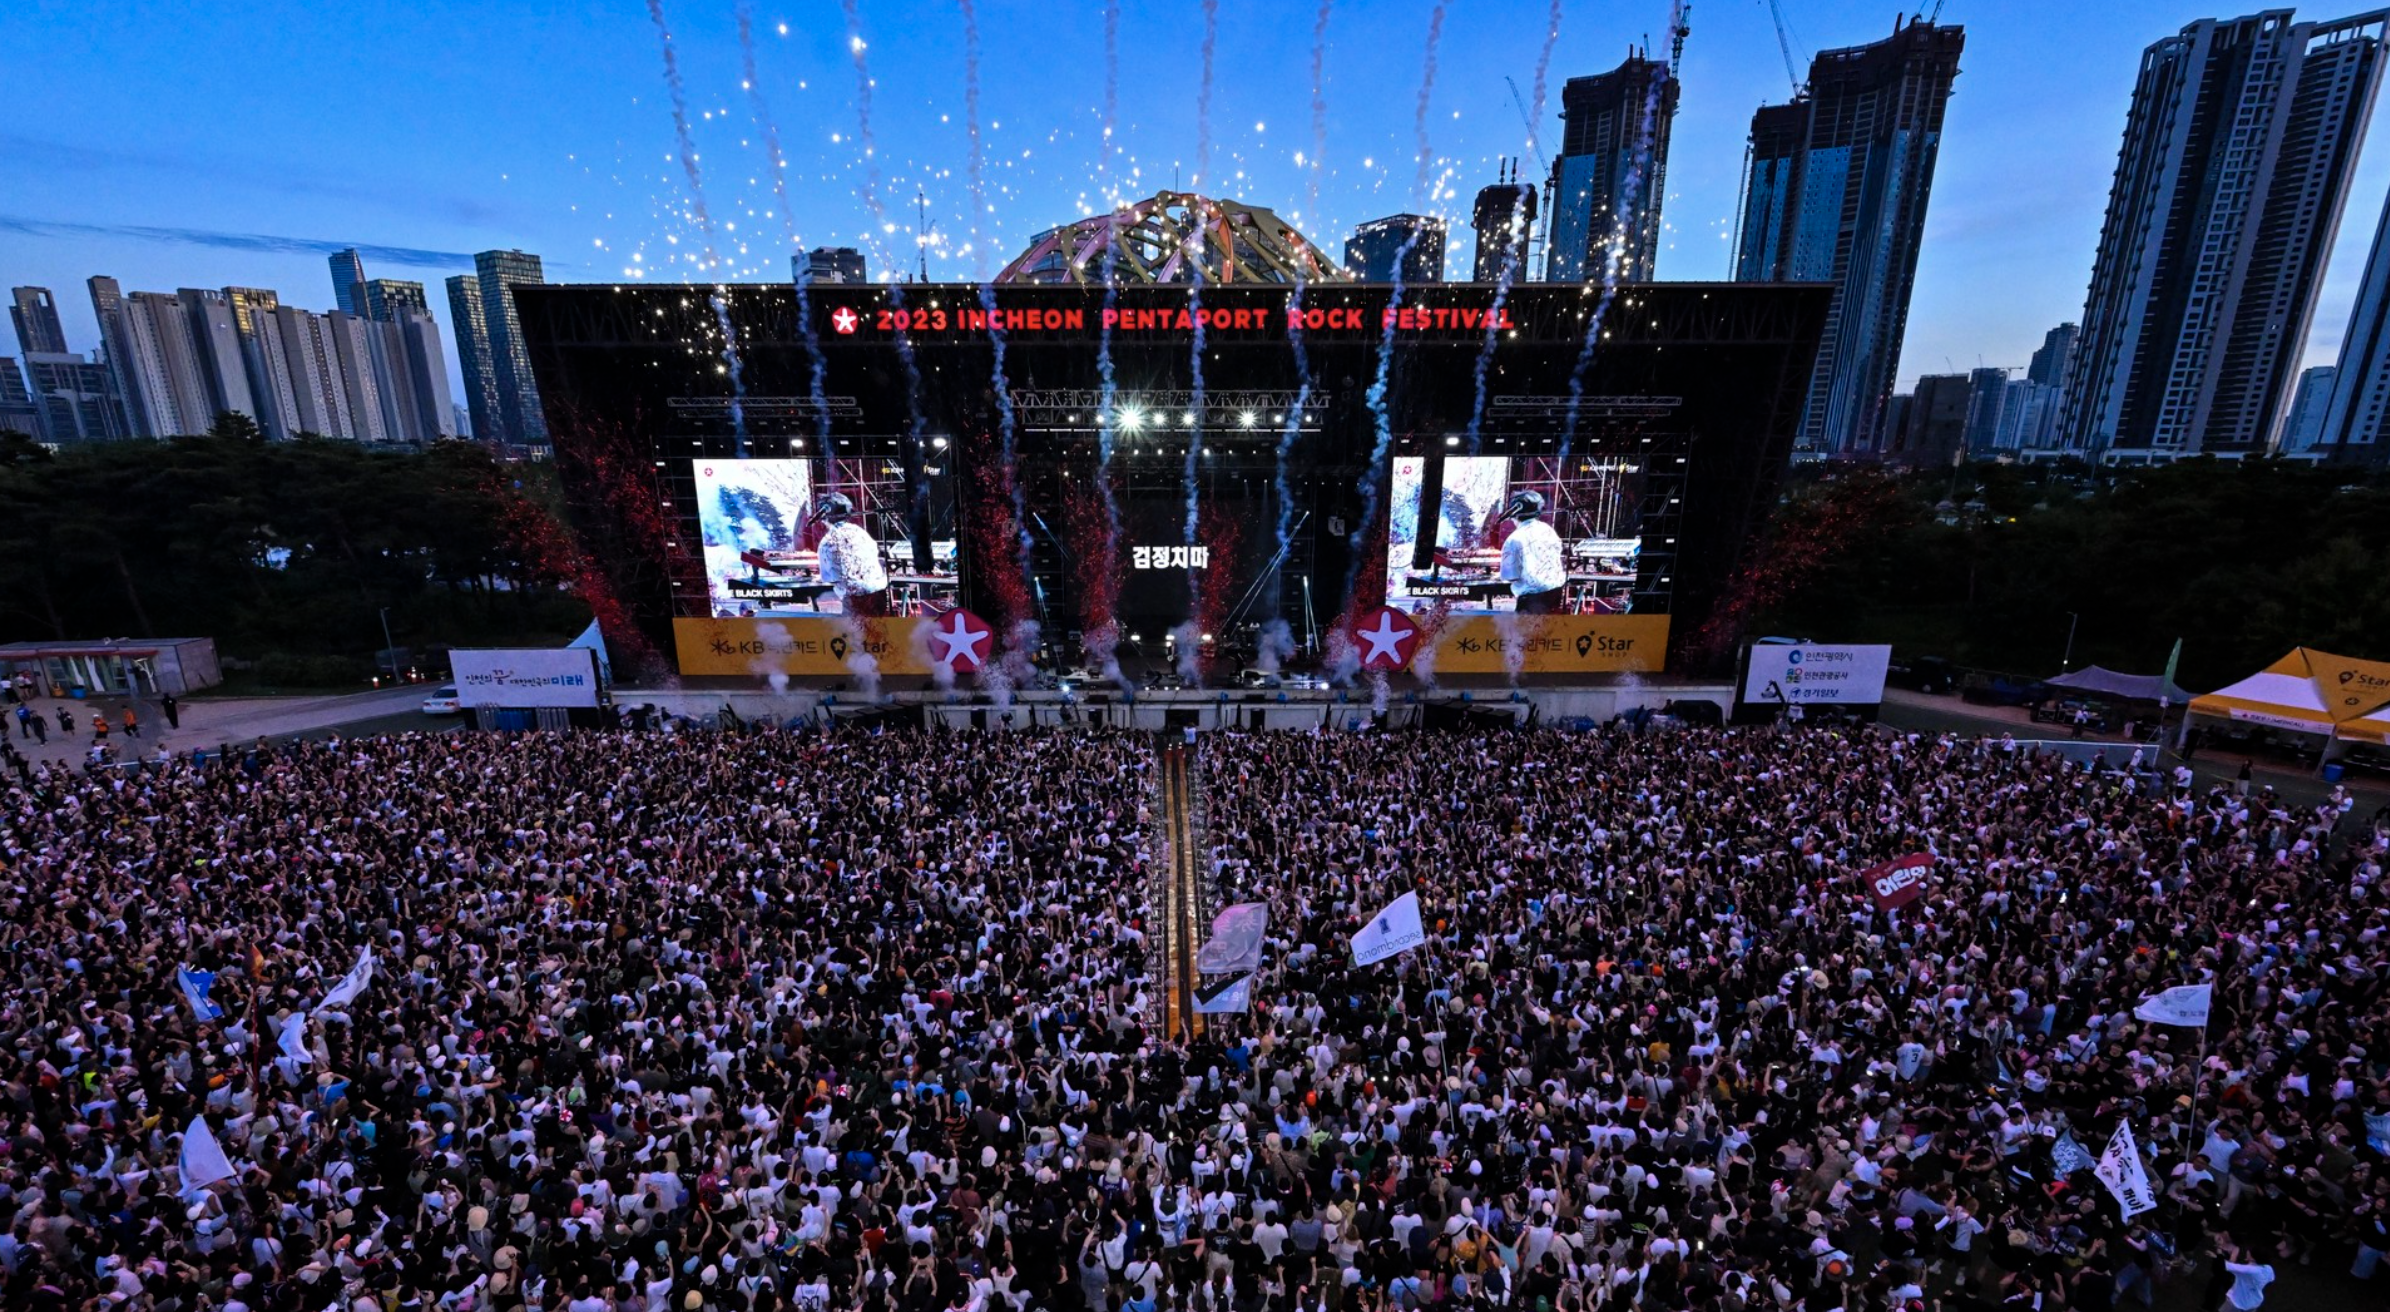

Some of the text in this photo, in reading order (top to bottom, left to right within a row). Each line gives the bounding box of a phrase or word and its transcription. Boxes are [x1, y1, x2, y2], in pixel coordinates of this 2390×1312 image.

[877, 308, 1514, 330] 2023 INCHEON PENTAPORT ROCK FESTIVAL
[1132, 546, 1210, 569] 검정치마
[735, 589, 763, 598] BLACK
[1411, 586, 1440, 596] BLACK
[1597, 635, 1635, 651] Star
[1805, 652, 1853, 662] 인천광역시
[465, 673, 493, 686] 인천의
[509, 676, 550, 687] 대한민국의
[551, 674, 584, 686] 미래
[1804, 671, 1849, 680] 인천관광공사
[1803, 688, 1840, 698] 경기일보
